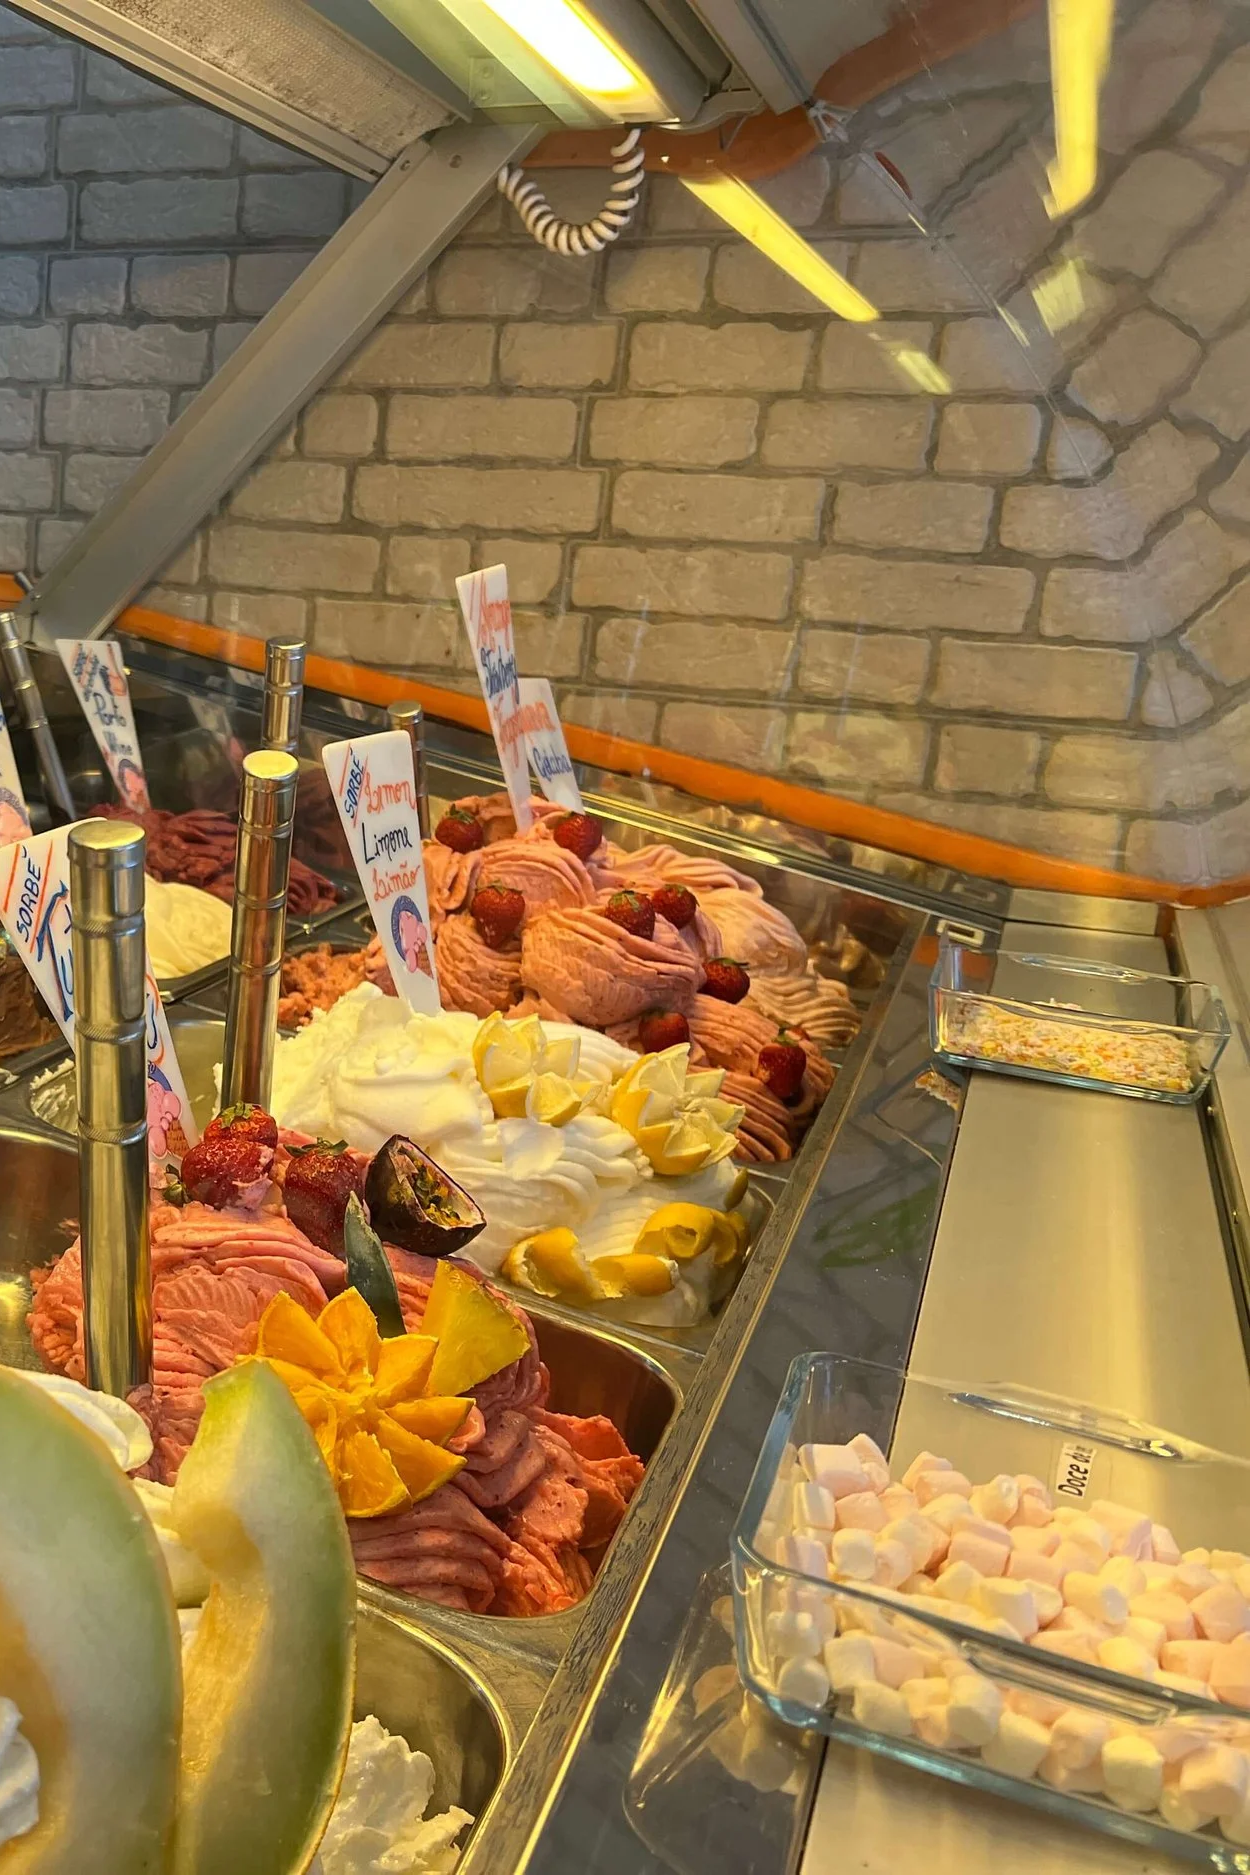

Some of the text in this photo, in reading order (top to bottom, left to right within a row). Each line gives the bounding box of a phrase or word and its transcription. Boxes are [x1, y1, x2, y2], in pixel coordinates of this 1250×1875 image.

[362, 822, 413, 864] Limone
[372, 863, 420, 902] Limão
[1057, 1463, 1089, 1497] Doce
